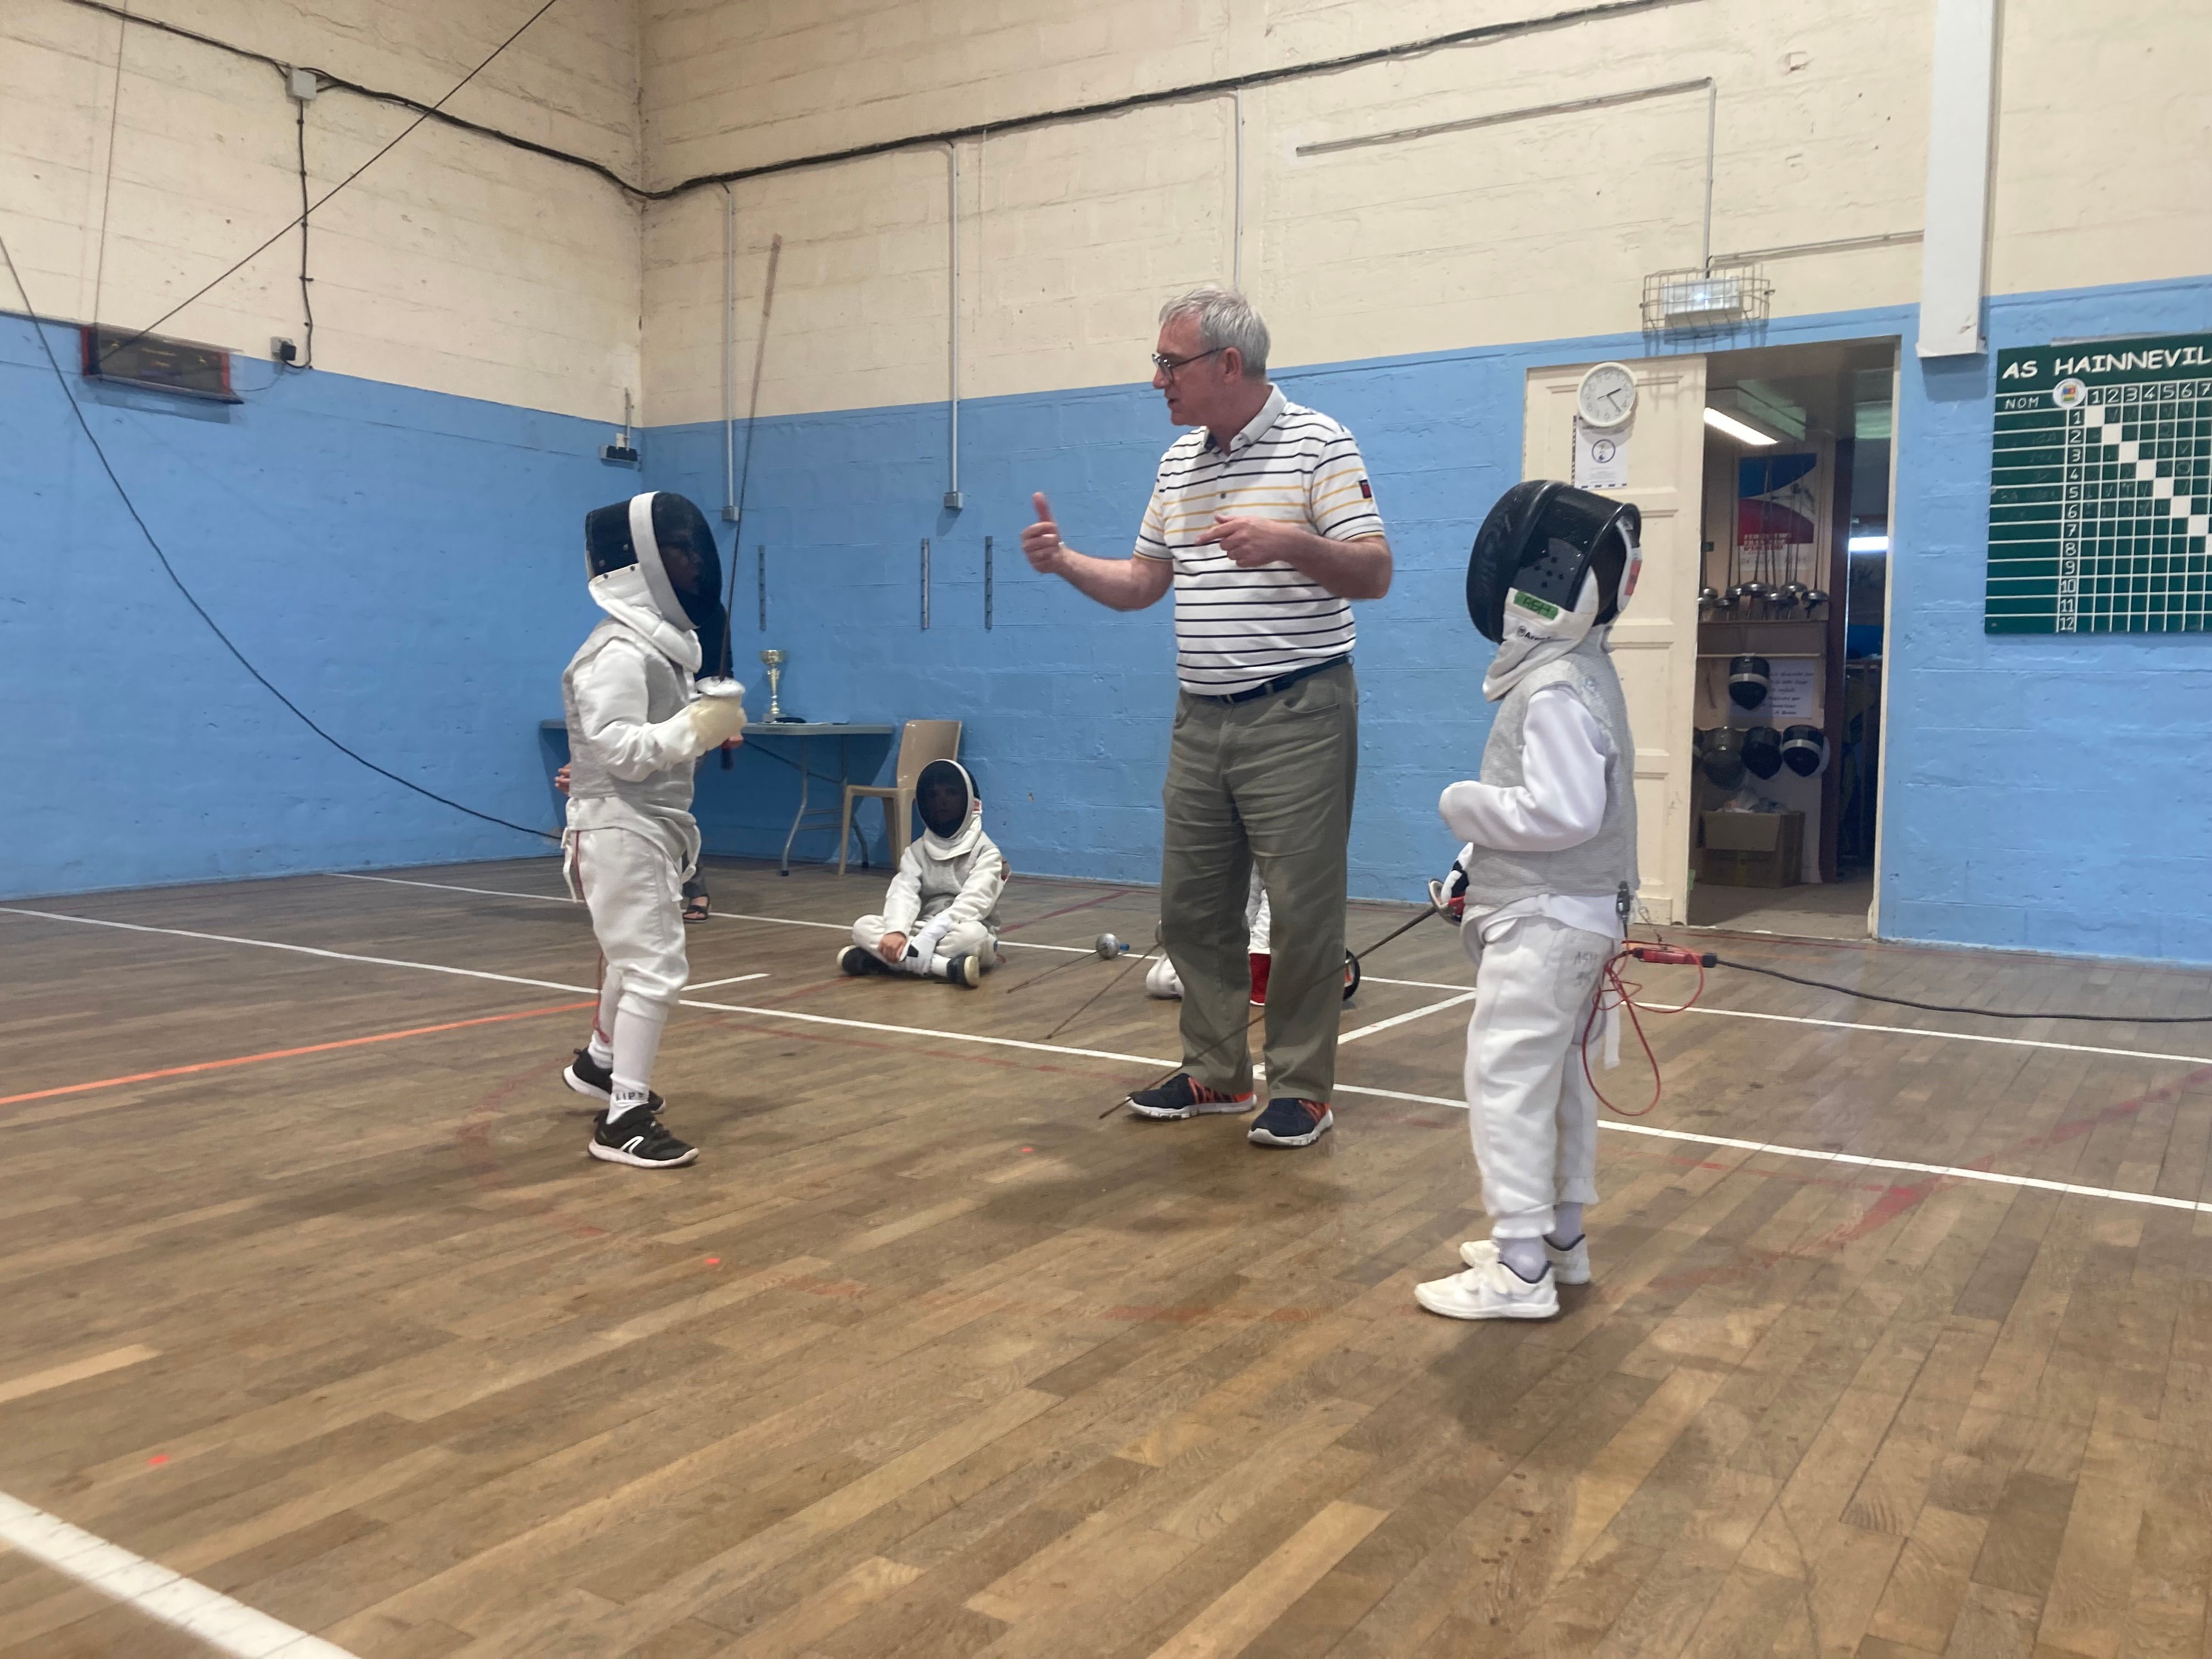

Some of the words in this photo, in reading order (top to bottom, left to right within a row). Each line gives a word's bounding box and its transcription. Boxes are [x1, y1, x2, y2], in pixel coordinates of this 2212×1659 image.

[2002, 360, 2038, 380] AS
[2053, 346, 2212, 376] HAINNEVIL
[2091, 390, 2101, 404] 1
[2107, 388, 2120, 403] 2
[2125, 387, 2138, 402] 3
[2144, 385, 2157, 399] 4
[2162, 385, 2175, 399] 5
[2181, 382, 2193, 398] 6
[2200, 382, 2212, 397] 7
[2005, 396, 2040, 410] NOM
[2073, 411, 2081, 425] 1
[2070, 431, 2082, 444] 2
[2071, 448, 2081, 462] 3
[2069, 467, 2080, 479] 4
[2068, 486, 2079, 499] 5
[2067, 504, 2078, 519] 6
[2066, 523, 2078, 537] 7
[2064, 541, 2076, 556] 8
[2065, 560, 2075, 575] 9
[2061, 579, 2077, 594] 10
[2060, 599, 2075, 613] 11
[2060, 617, 2075, 631] 12
